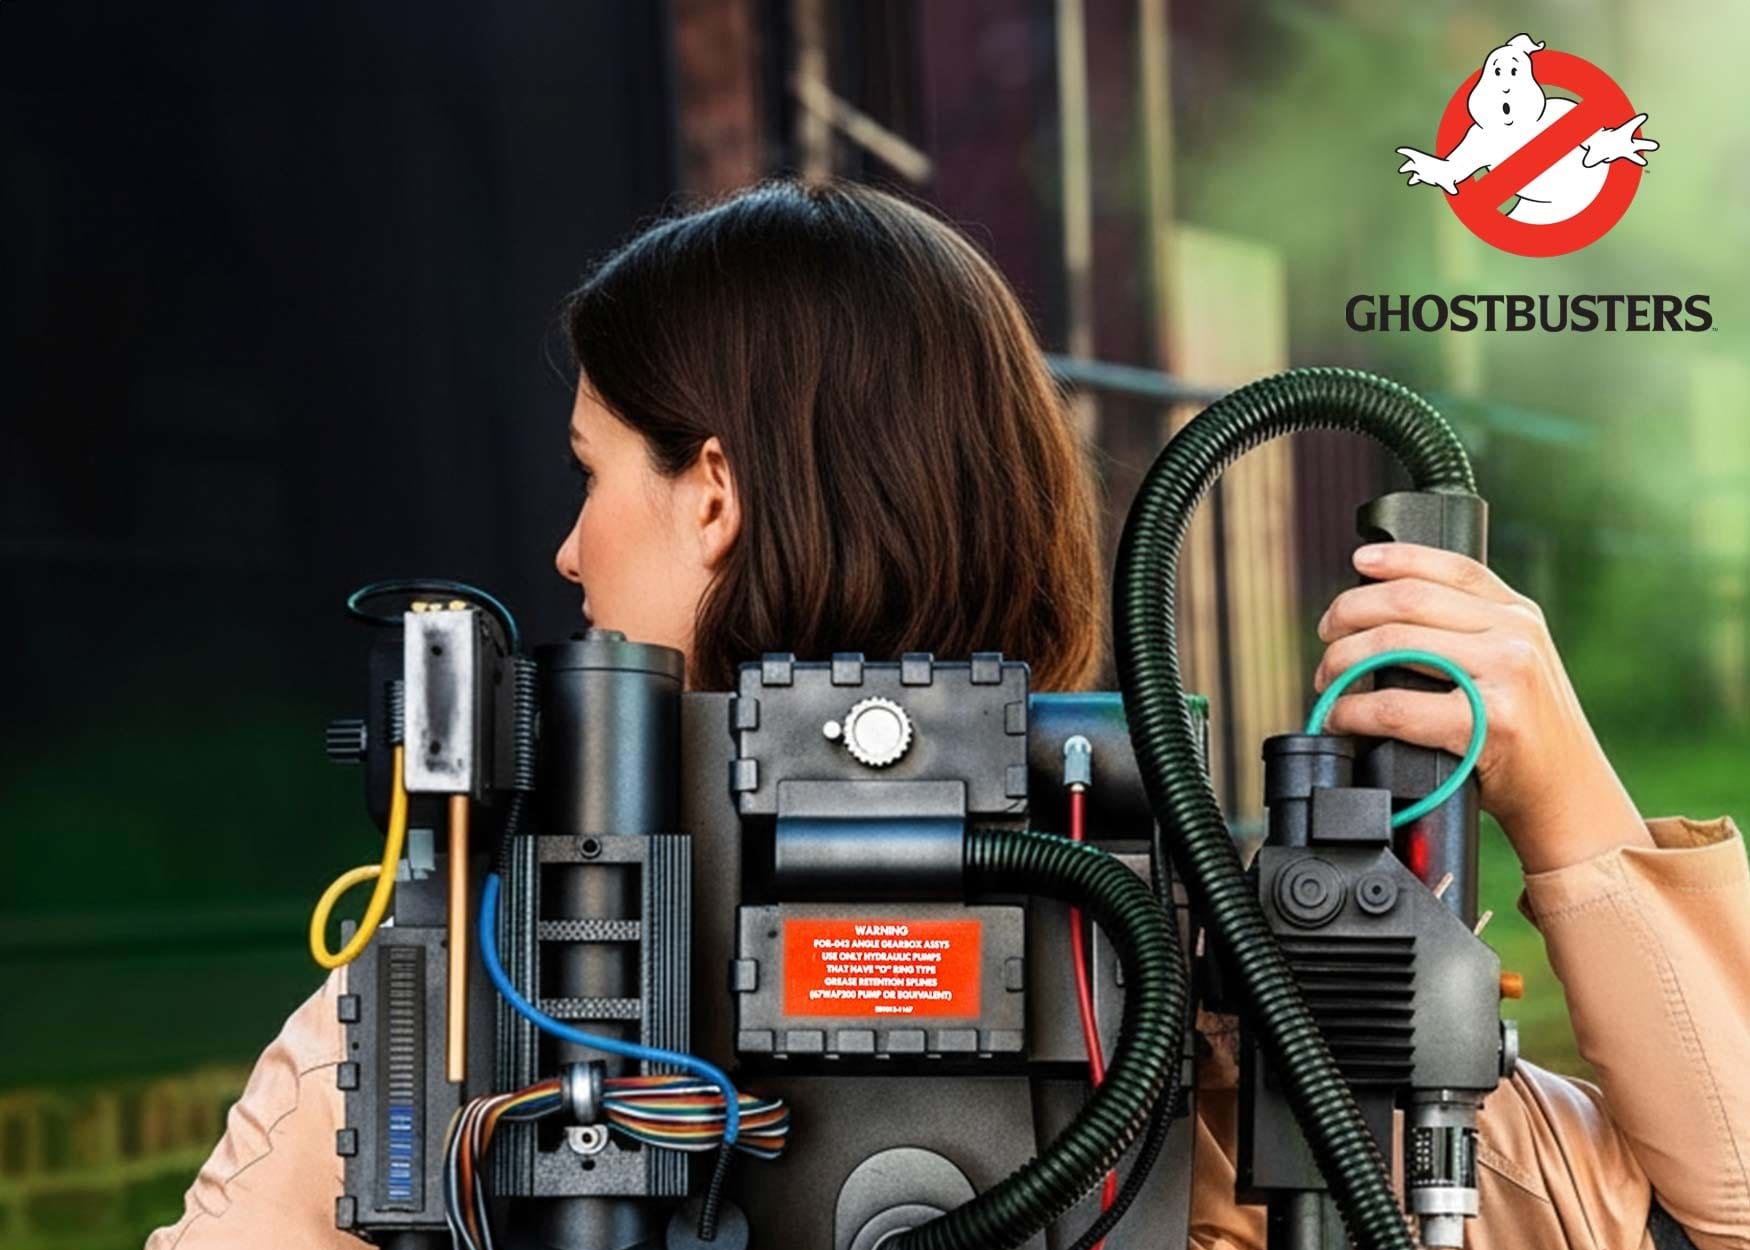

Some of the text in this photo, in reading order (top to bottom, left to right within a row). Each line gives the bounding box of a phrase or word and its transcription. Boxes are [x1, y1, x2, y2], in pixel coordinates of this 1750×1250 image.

[854, 924, 909, 937] WARNING
[851, 938, 880, 949] ANGLE
[881, 939, 922, 949] GEARBOX
[821, 951, 942, 962] USE ONLY HYDRAULIC PUMPS
[826, 964, 849, 974] THAT
[849, 964, 874, 974] HAVE
[892, 964, 915, 974] RING
[915, 964, 937, 975] TYPE
[823, 976, 858, 987] GREASE
[858, 976, 905, 987] RETENTION
[857, 989, 882, 999] PUMP
[882, 990, 897, 1000] OR
[897, 990, 952, 1002] EQUIVALENT)
